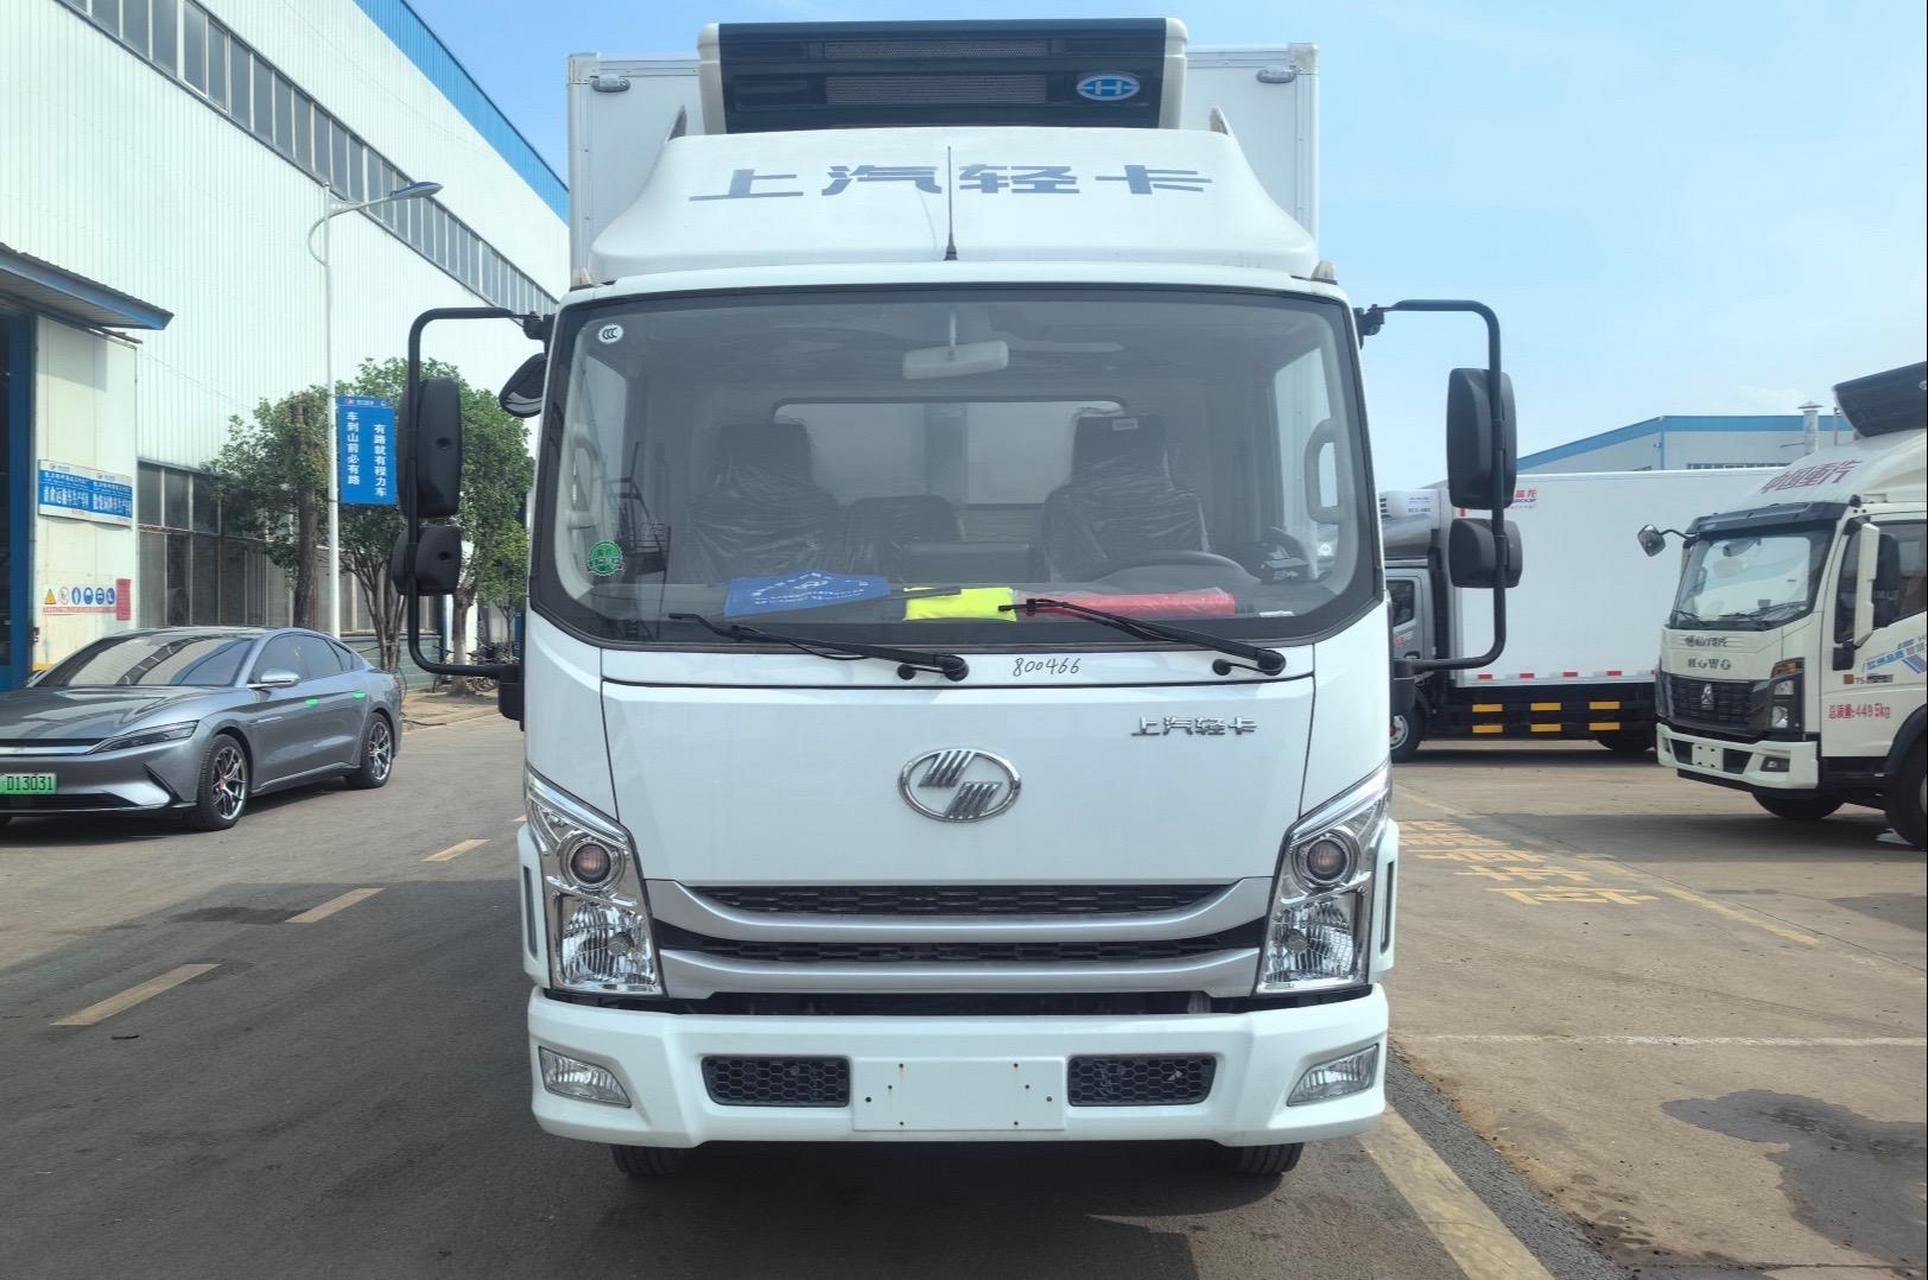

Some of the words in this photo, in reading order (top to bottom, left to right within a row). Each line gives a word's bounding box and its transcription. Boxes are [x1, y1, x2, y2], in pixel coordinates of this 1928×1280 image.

[689, 163, 1213, 201] 上汽轻卡
[345, 411, 360, 486] 车到山前必有路
[1760, 459, 1862, 494] 中国重汽
[1012, 657, 1081, 678] 800466
[1130, 717, 1258, 736] 上汽轻卡
